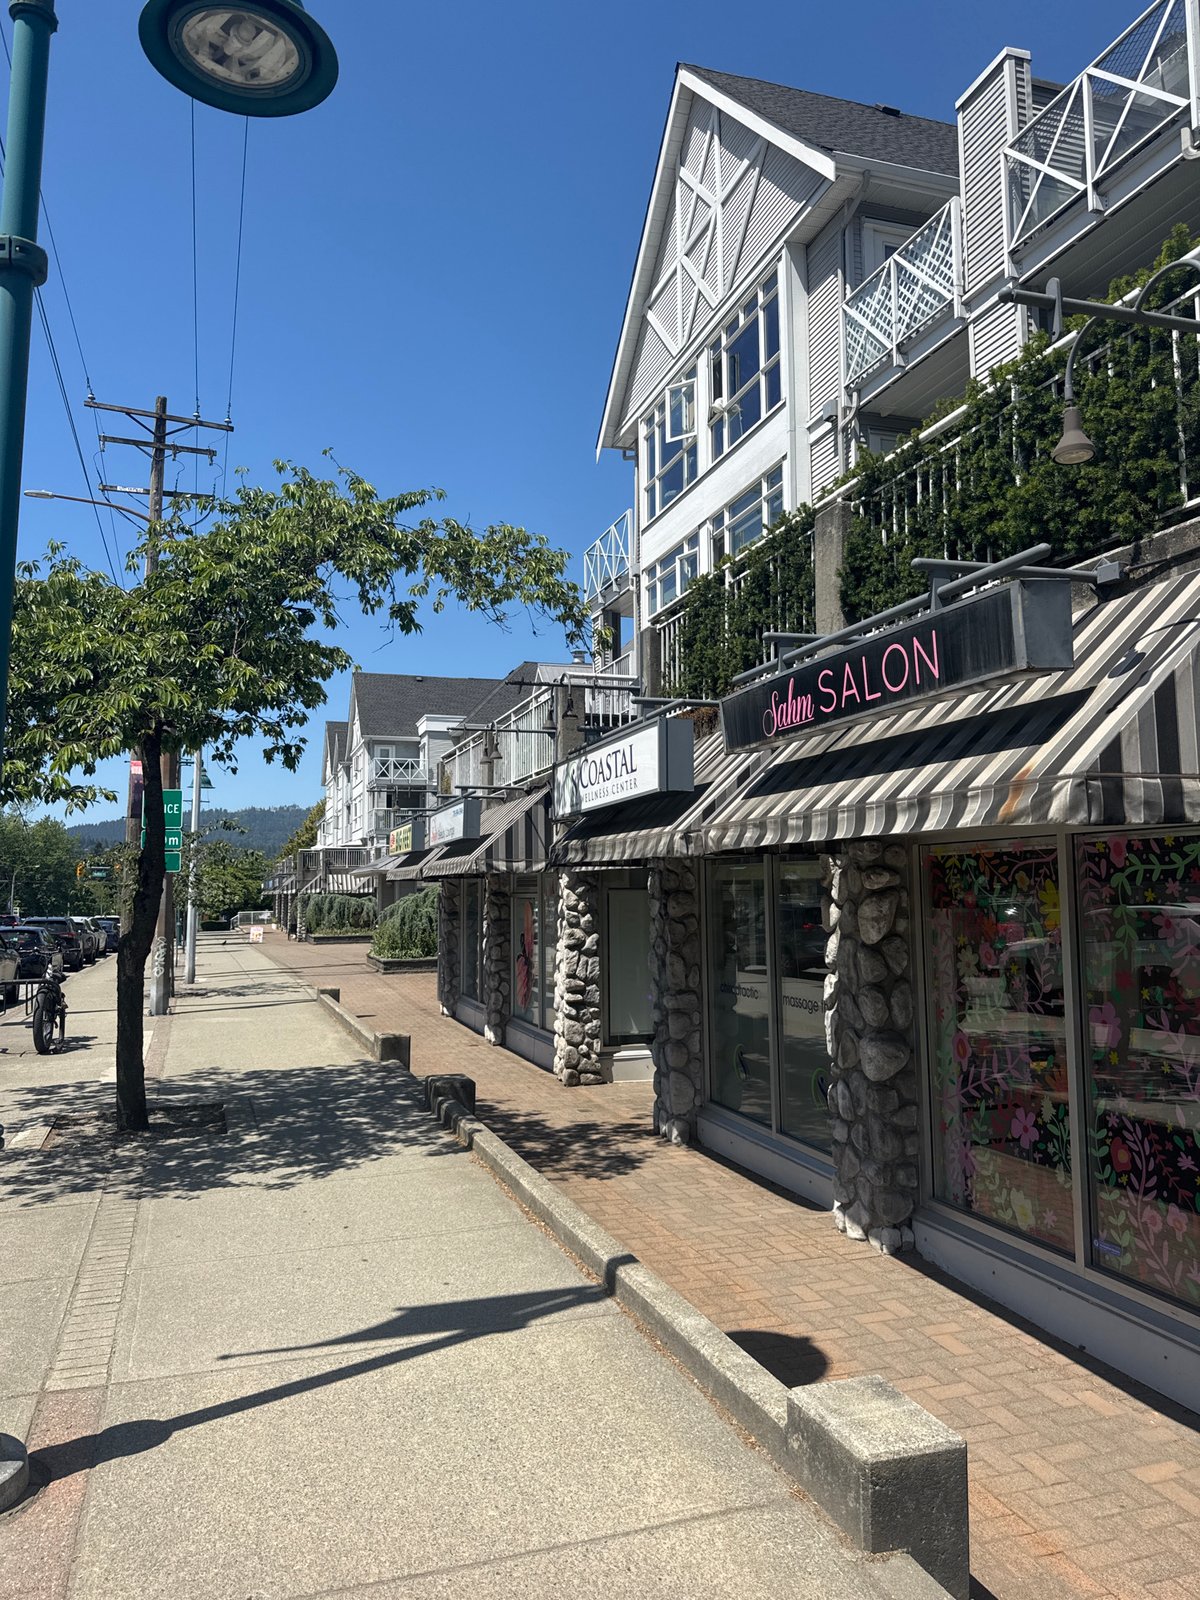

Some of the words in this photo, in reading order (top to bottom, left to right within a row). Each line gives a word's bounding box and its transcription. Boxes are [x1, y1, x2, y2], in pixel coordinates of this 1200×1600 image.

[762, 677, 815, 737] Sahm
[818, 630, 939, 713] SALON
[579, 743, 638, 789] COASTAL
[611, 777, 639, 795] CENTER
[163, 803, 180, 814] ICE
[782, 994, 819, 1014] massage
